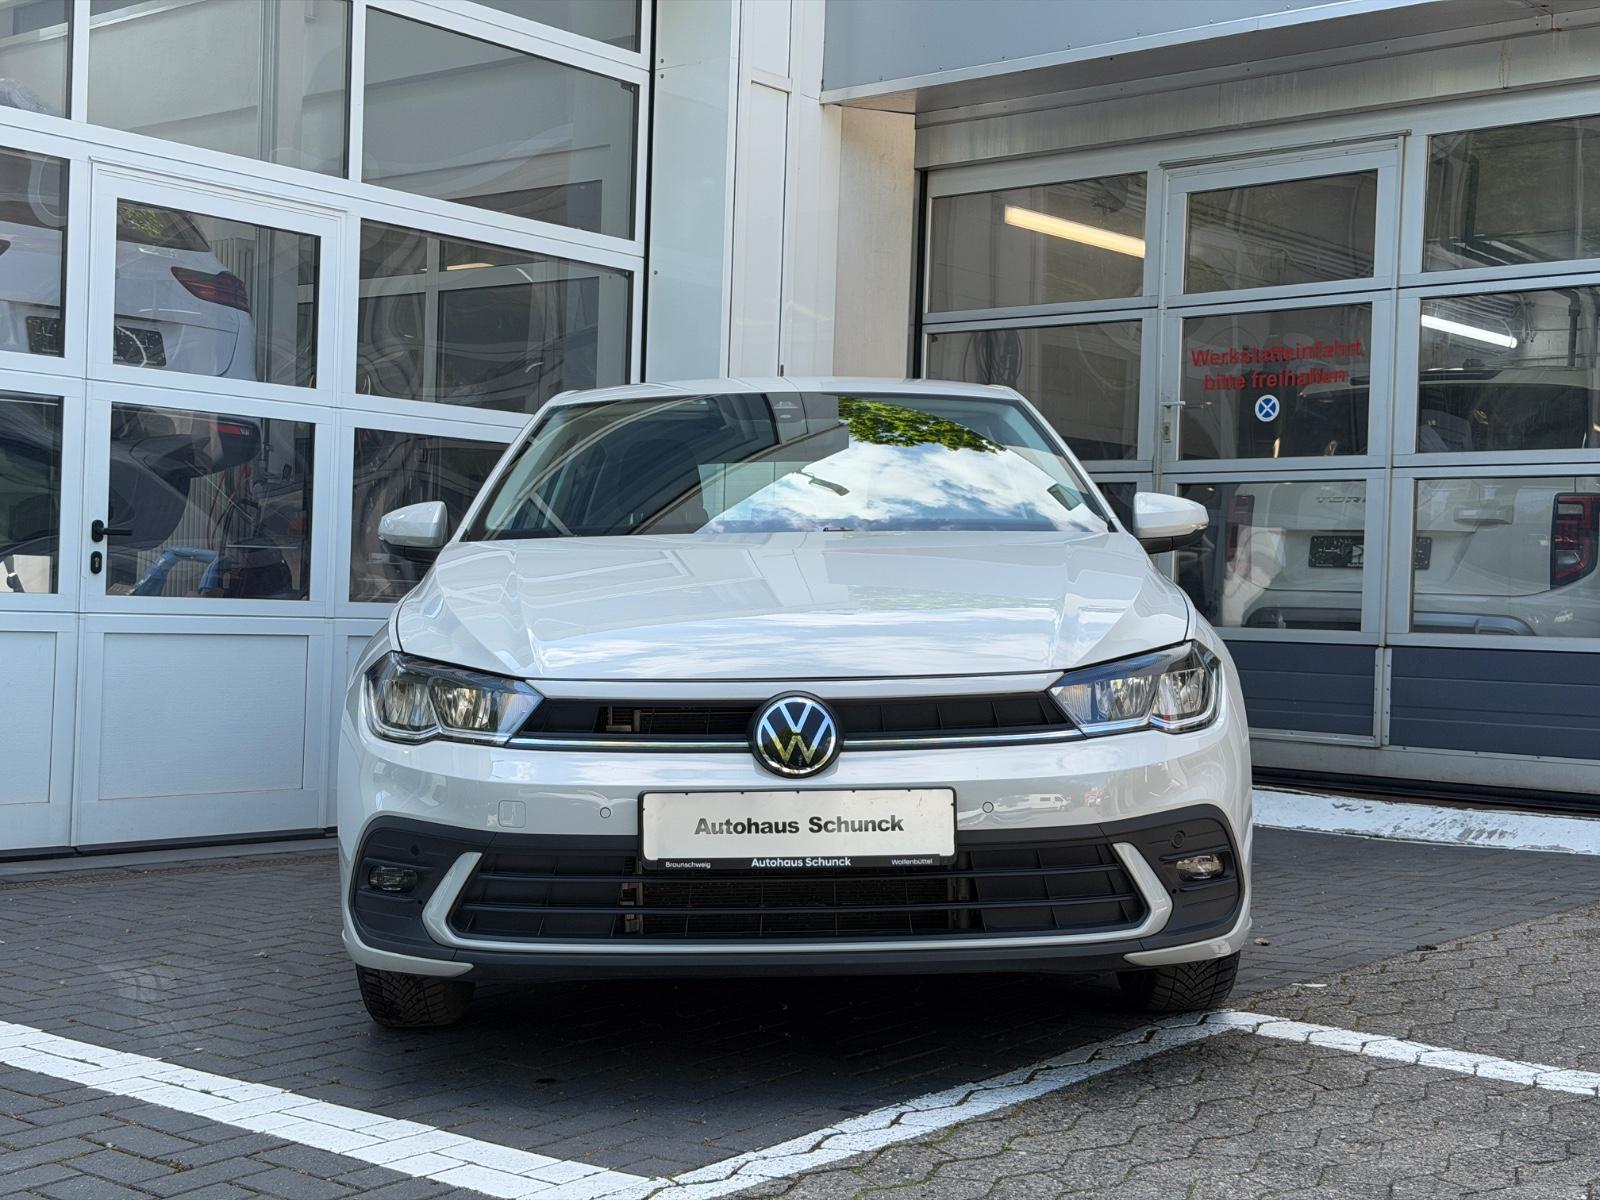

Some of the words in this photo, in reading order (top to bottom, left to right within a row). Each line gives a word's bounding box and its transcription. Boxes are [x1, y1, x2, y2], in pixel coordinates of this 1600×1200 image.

[1251, 367, 1347, 389] freihalten
[694, 817, 800, 835] Autohaus
[808, 814, 905, 834] Schunck
[665, 861, 711, 869] Braunschweig
[751, 858, 803, 868] Autohaus
[805, 857, 851, 867] Schunck
